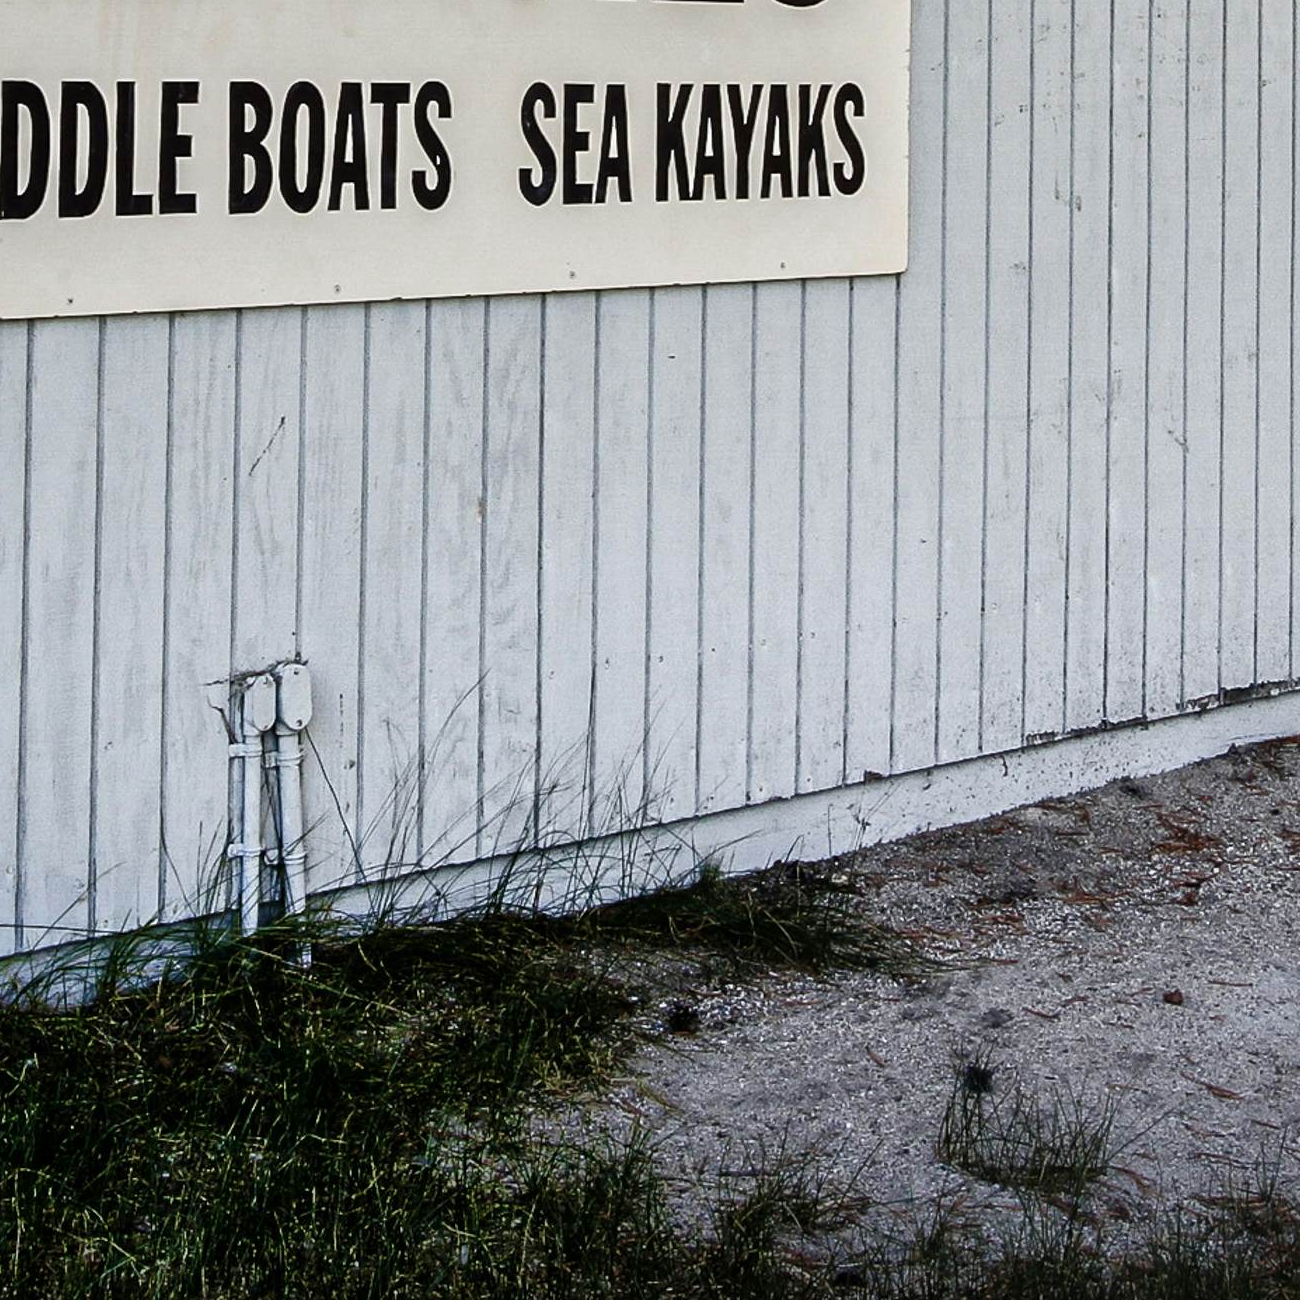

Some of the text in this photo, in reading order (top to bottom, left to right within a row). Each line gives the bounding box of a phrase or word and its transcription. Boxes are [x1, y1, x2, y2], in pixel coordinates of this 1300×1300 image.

[228, 82, 452, 215] BOATS
[518, 82, 633, 206] SEA
[655, 83, 865, 202] KAYAKS
